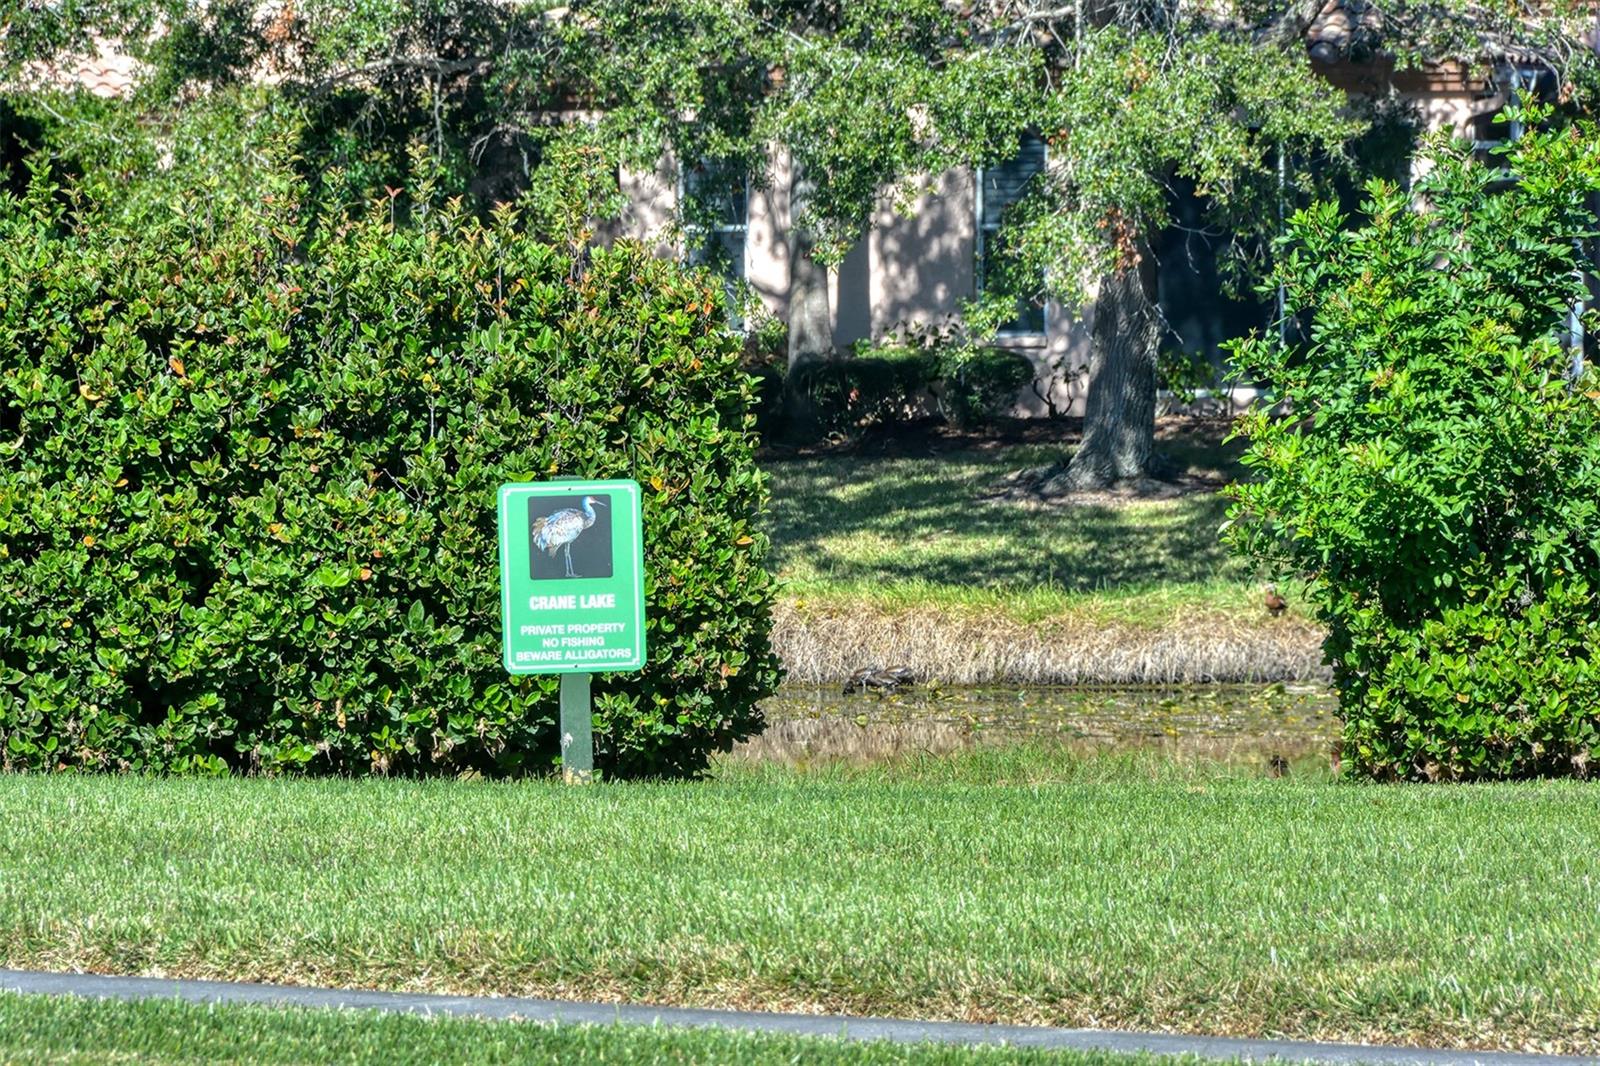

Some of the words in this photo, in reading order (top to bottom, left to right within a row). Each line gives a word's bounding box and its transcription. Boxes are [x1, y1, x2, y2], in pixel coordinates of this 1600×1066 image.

[529, 595, 576, 610] CRANE
[580, 594, 615, 609] LAKE
[520, 624, 565, 635] PRIVATE
[567, 622, 626, 634] PROPERTY
[542, 637, 559, 648] NO
[561, 636, 605, 647] FISHING
[516, 650, 562, 661] BEWARE
[564, 648, 631, 660] ALLIGATORS
